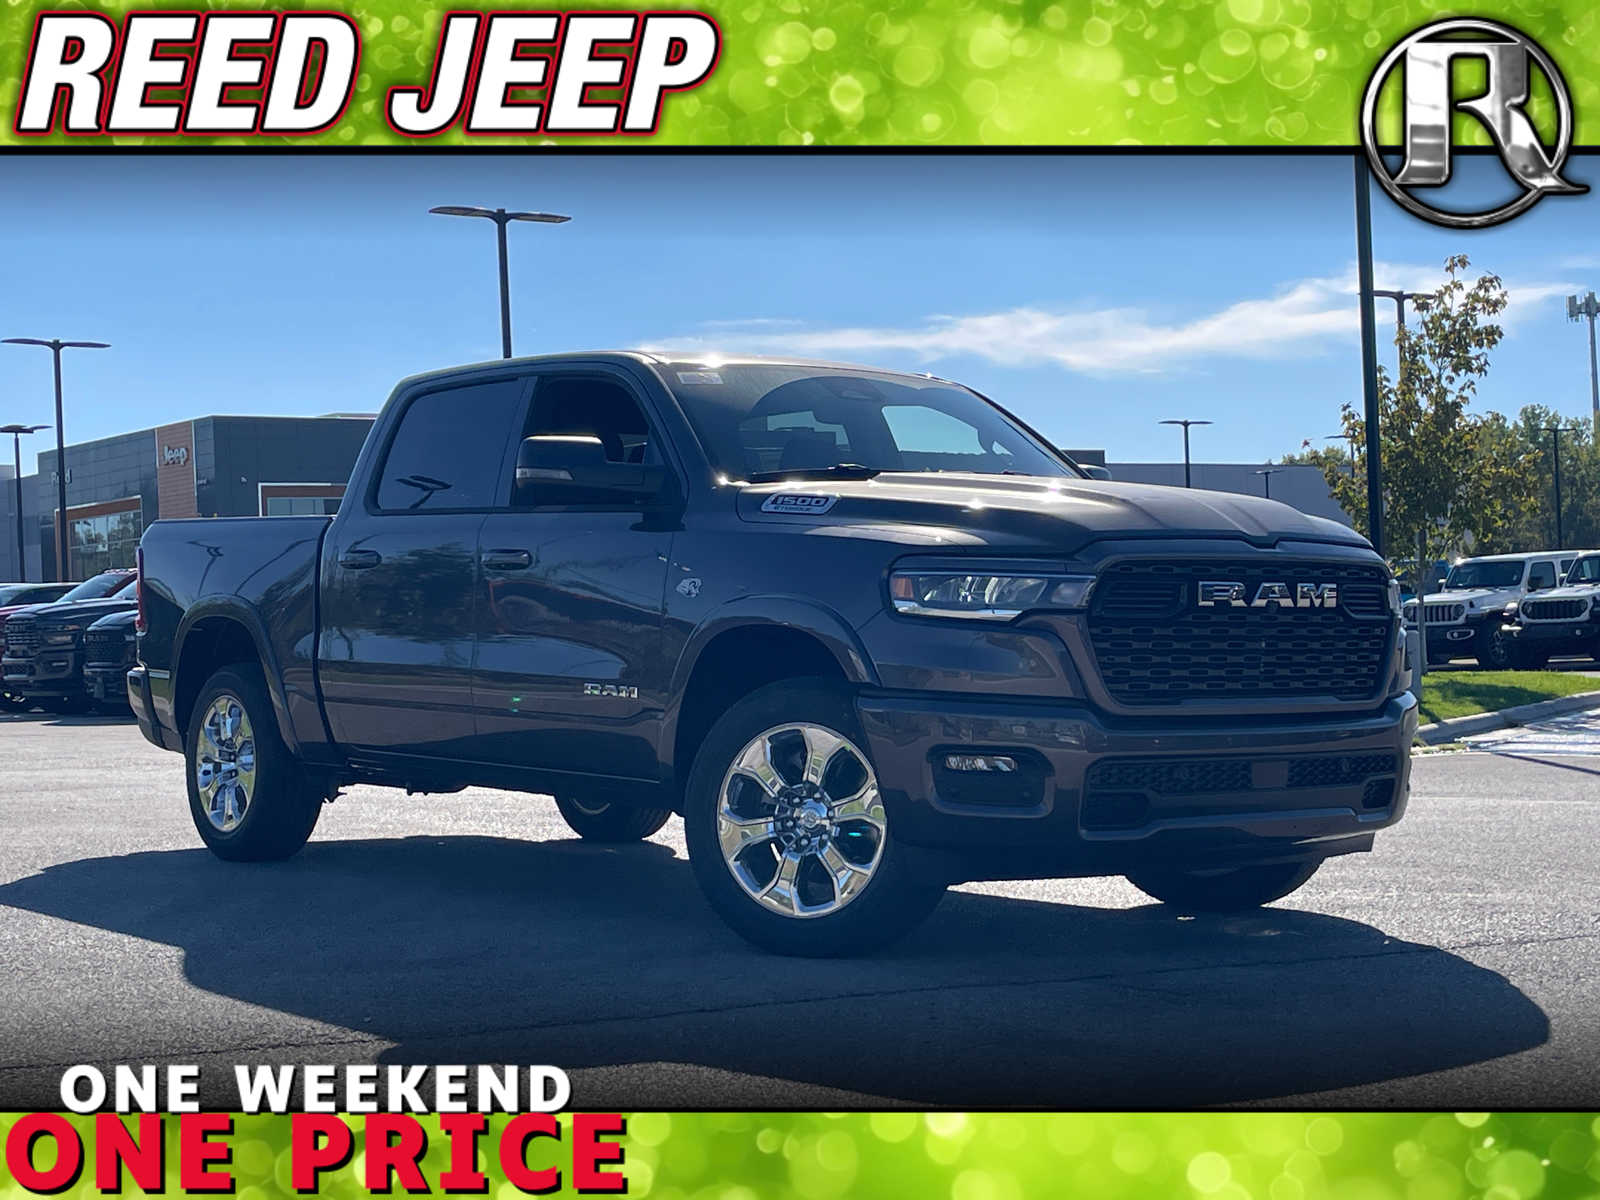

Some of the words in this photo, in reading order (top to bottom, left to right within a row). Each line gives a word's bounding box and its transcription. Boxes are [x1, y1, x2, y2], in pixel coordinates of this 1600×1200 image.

[163, 445, 188, 465] Jeep
[776, 496, 827, 506] 1500
[1198, 580, 1337, 607] RAM
[583, 683, 638, 699] RAM
